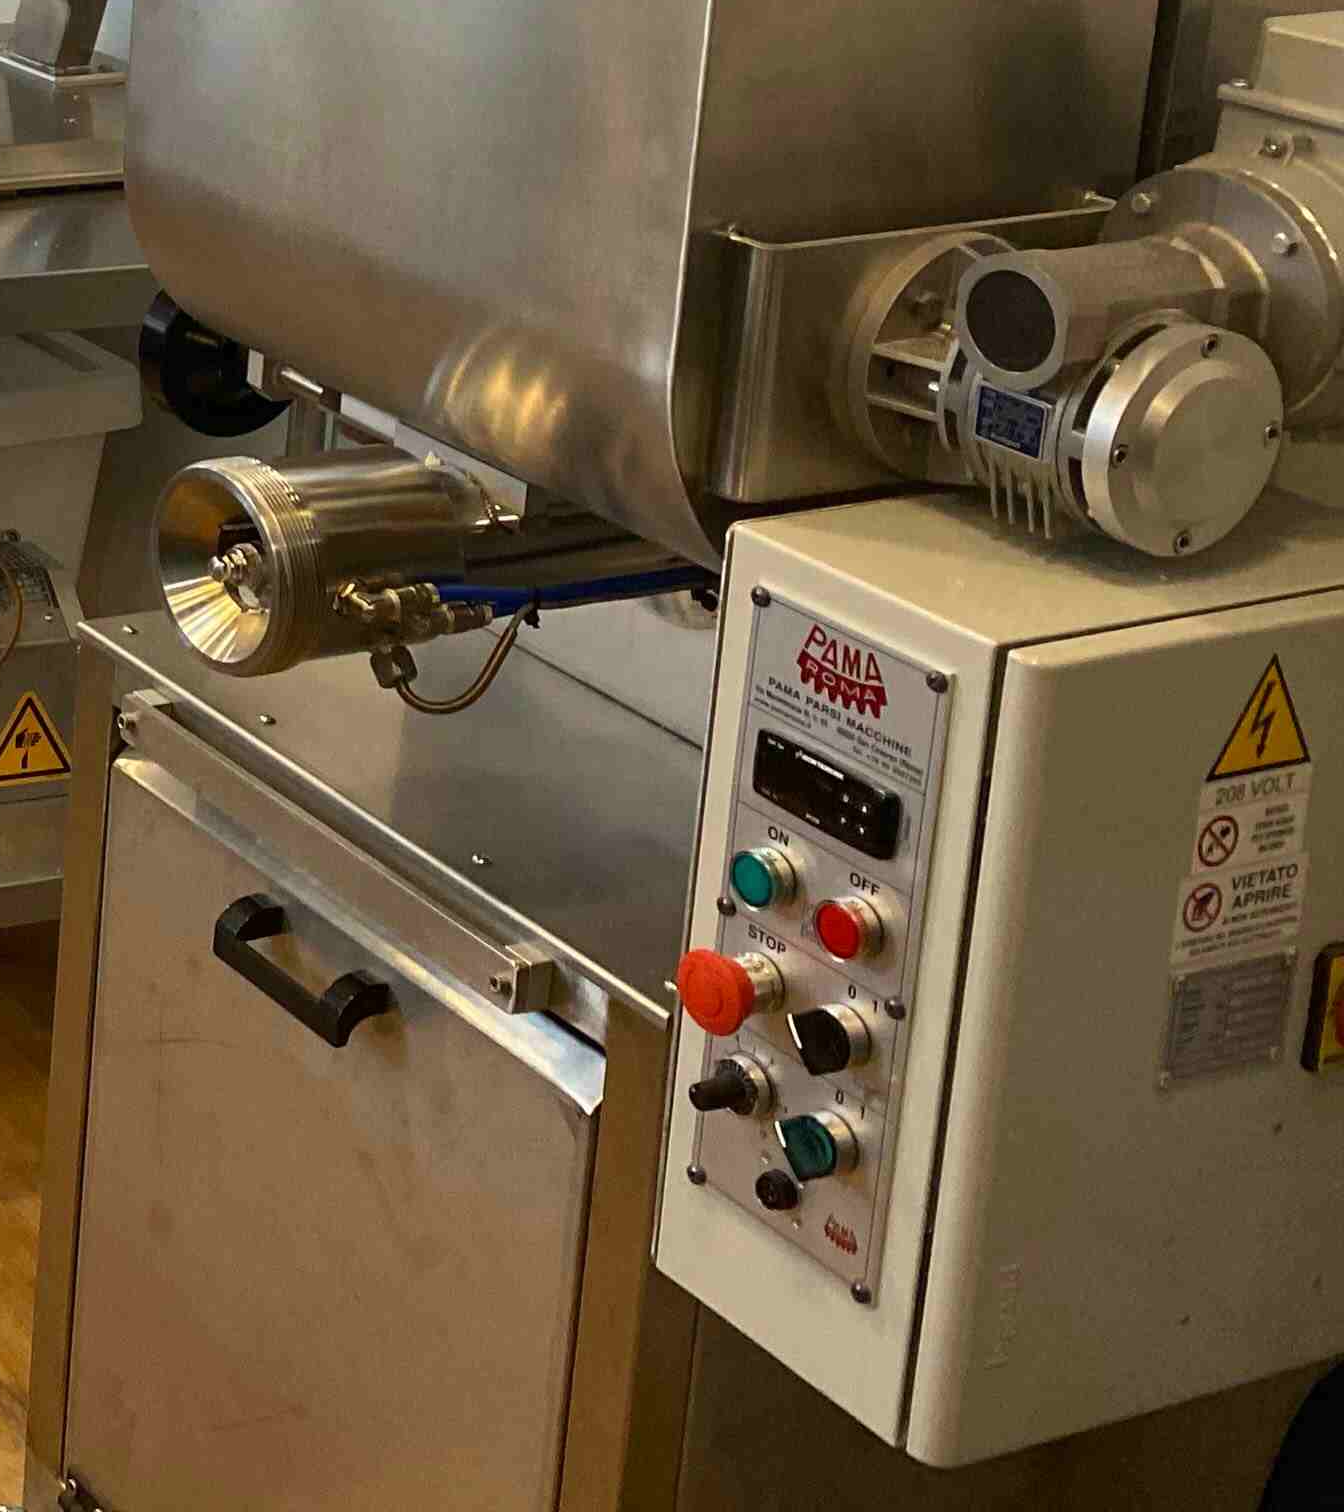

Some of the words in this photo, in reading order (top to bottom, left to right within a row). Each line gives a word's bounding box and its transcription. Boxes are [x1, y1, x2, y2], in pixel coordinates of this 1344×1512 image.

[804, 623, 884, 685] PAMA
[805, 660, 878, 703] ROMA
[768, 675, 801, 701] PAMA
[805, 696, 842, 723] PARSI
[846, 717, 912, 758] MACCHINE
[1251, 772, 1297, 796] VOLT
[767, 826, 790, 847] ON
[849, 872, 881, 897] OFF
[1232, 863, 1299, 890] VIETATO
[1231, 883, 1292, 909] APRIRE
[747, 923, 787, 955] STOP
[847, 984, 857, 1000] 0
